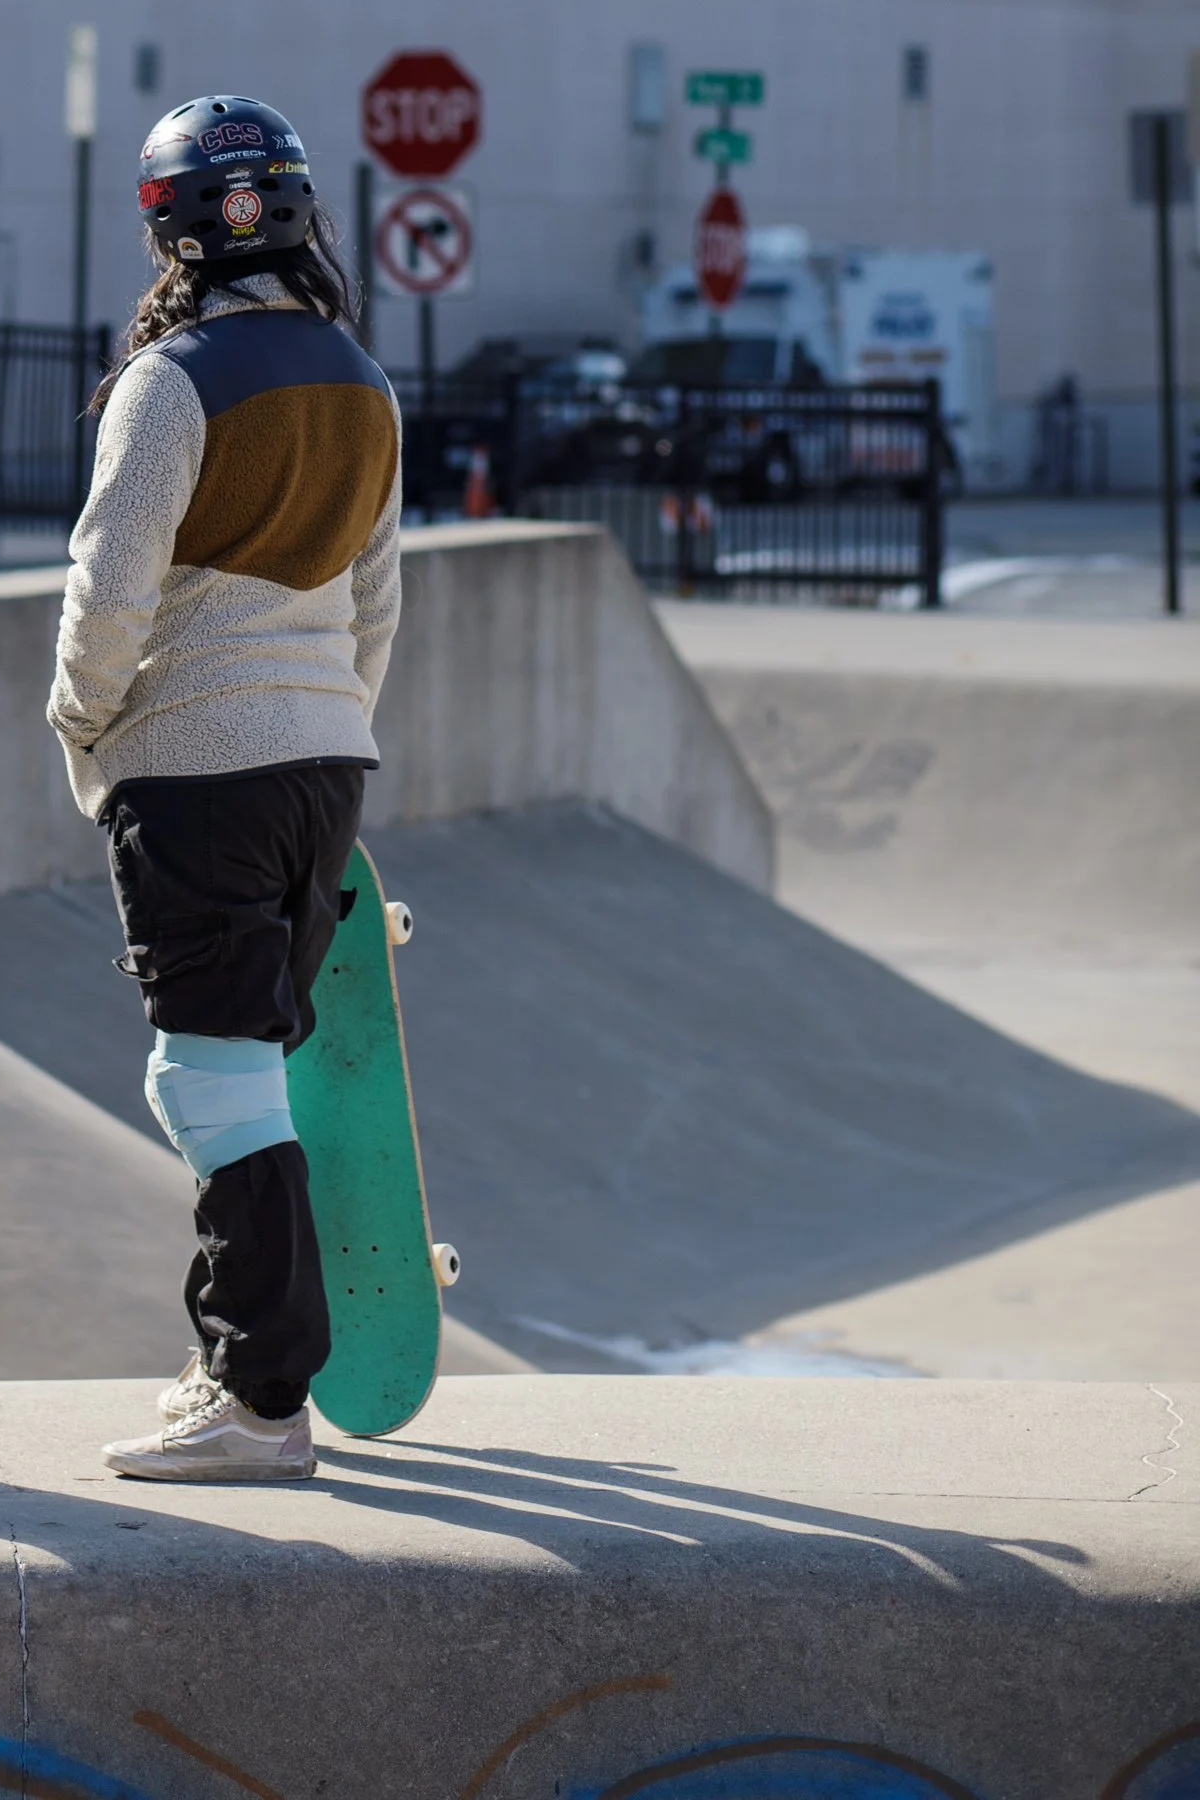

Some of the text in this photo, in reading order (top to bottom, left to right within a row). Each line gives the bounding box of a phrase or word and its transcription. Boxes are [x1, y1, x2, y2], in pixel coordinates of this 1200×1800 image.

[370, 87, 473, 144] STOP
[198, 122, 263, 153] CCS
[209, 149, 267, 163] CORTECH
[697, 221, 744, 273] STOP
